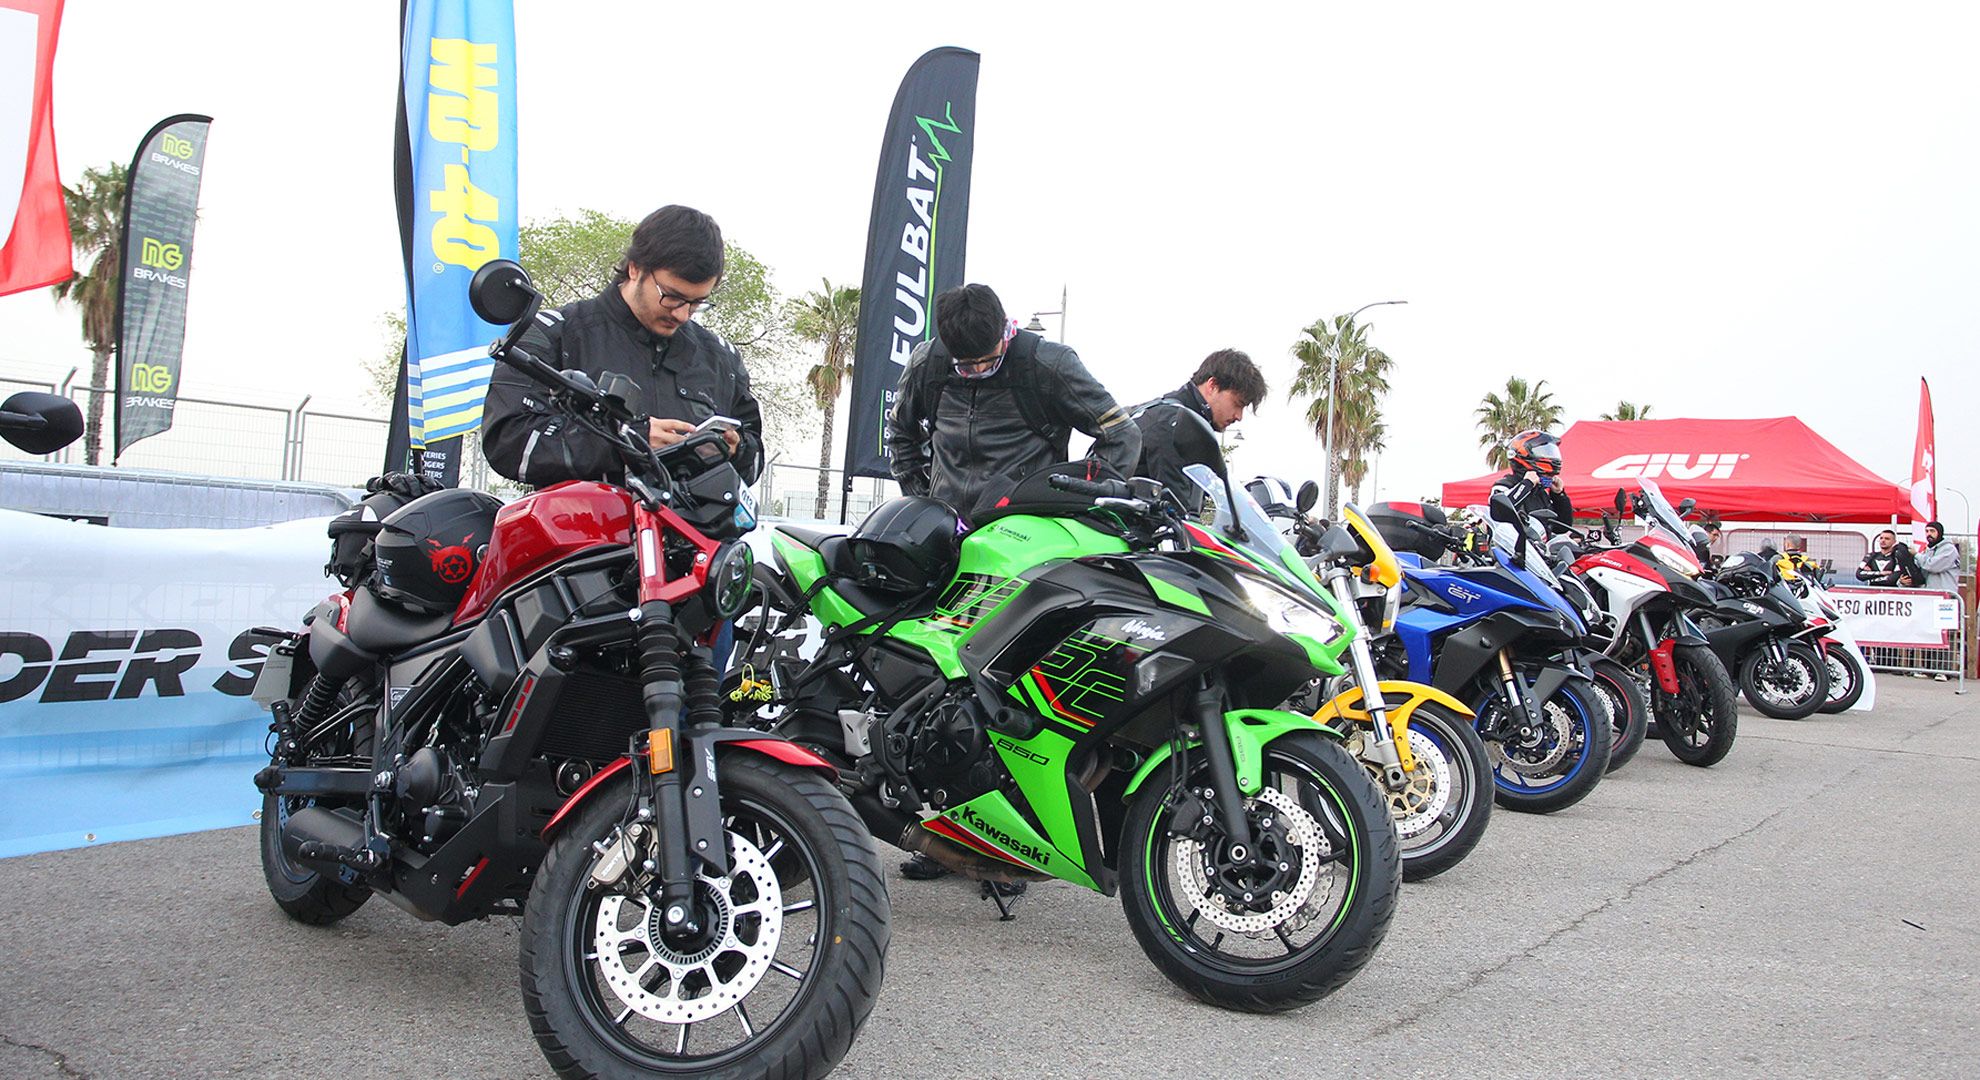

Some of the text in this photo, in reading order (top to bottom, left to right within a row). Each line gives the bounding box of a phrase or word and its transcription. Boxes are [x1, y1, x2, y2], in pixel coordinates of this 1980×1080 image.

[152, 152, 200, 175] BRAKES
[428, 37, 499, 272] WD-40
[890, 142, 936, 367] FULBAT
[133, 267, 186, 289] BRAKES
[125, 396, 175, 409] BRAKES
[1591, 453, 1740, 480] GIVI
[1832, 598, 1913, 617] ESO RIDERS
[1120, 619, 1166, 641] Ninja
[961, 805, 1051, 866] Kawasaki
